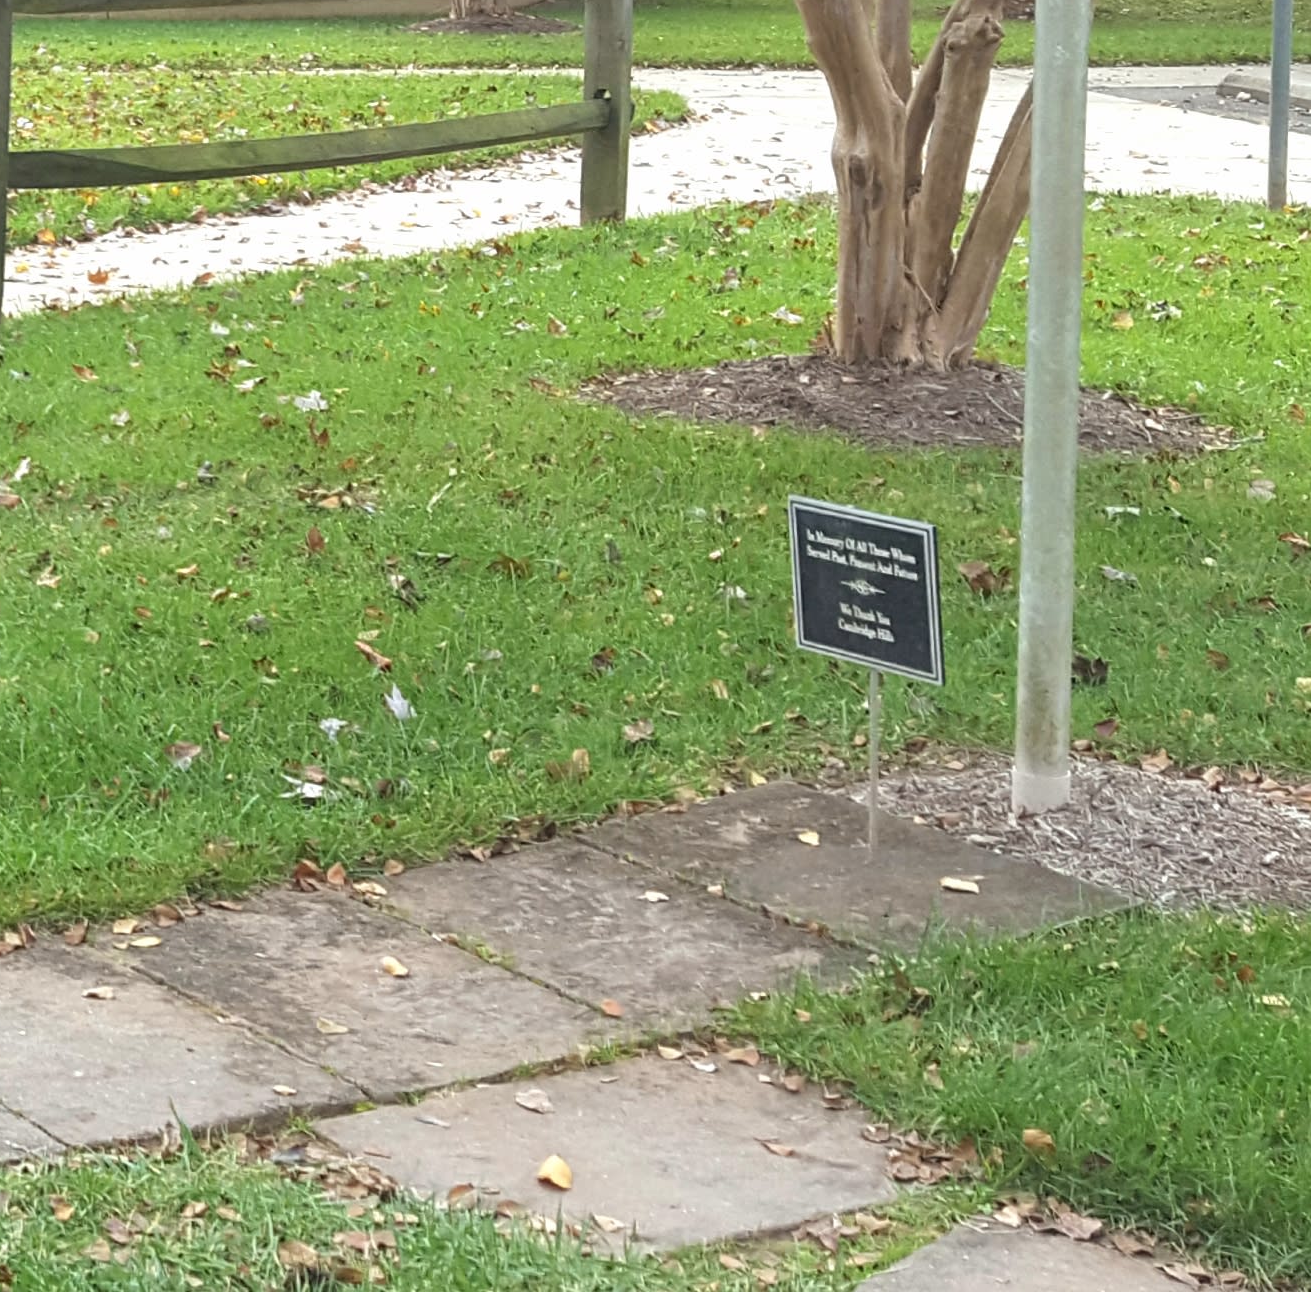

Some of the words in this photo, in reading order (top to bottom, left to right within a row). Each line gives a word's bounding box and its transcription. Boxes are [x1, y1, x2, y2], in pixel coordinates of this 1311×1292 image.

[806, 528, 815, 541] In
[815, 530, 844, 550] Memory
[856, 540, 867, 553] All
[806, 544, 830, 561] Served
[849, 553, 875, 572] Present
[877, 560, 893, 575] And
[839, 602, 852, 616] We
[852, 604, 875, 622] Thank
[838, 617, 876, 639] Cambridge
